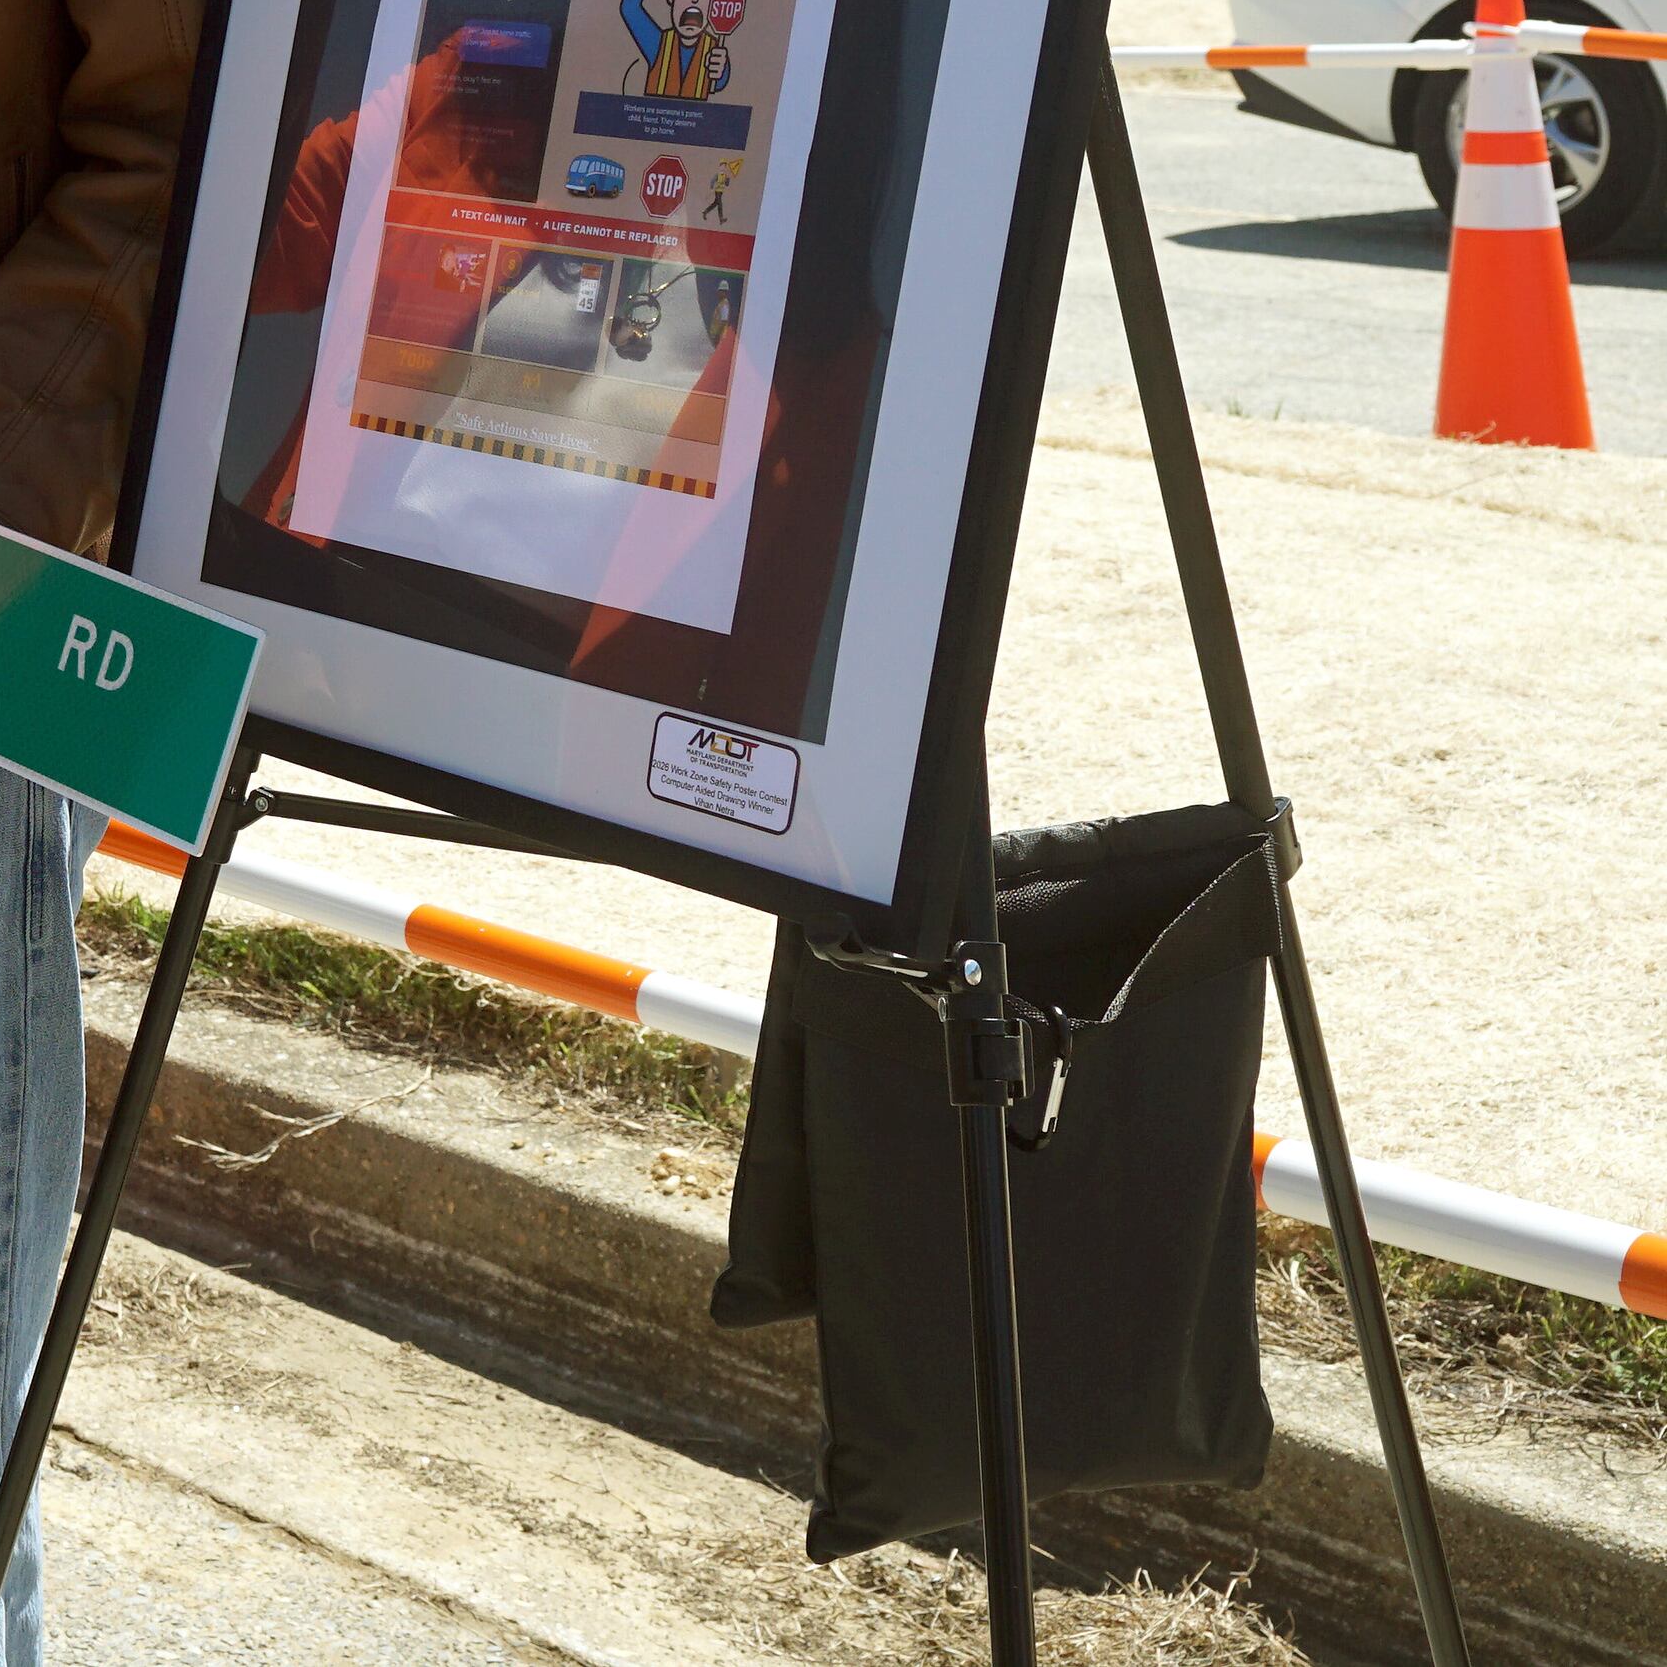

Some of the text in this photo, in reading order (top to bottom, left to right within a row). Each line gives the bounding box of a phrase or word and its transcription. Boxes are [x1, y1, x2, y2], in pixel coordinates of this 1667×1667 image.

[711, 0, 741, 19] STOP
[624, 104, 645, 114] Workers
[660, 117, 674, 127] They
[675, 120, 696, 128] deserve
[646, 173, 683, 199] STOP
[452, 209, 678, 247] A TEXT CAN WAIT A LIFE CANNOT BE REPLACED
[578, 298, 594, 310] 45
[485, 419, 527, 438] Actions
[531, 427, 560, 443] Save
[57, 614, 135, 692] RD
[688, 728, 760, 762] MDOT
[686, 748, 754, 772] MARYLAND DEPARTMENT
[699, 760, 747, 778] TRANSPORTATION
[661, 774, 775, 815] Computer Aided Drawing Winner
[670, 764, 689, 777] Work
[690, 770, 708, 783] Zone
[710, 776, 732, 792] Safety
[734, 782, 757, 797] Poster
[759, 791, 788, 806] Contest
[694, 797, 735, 816] Vihan Netra
